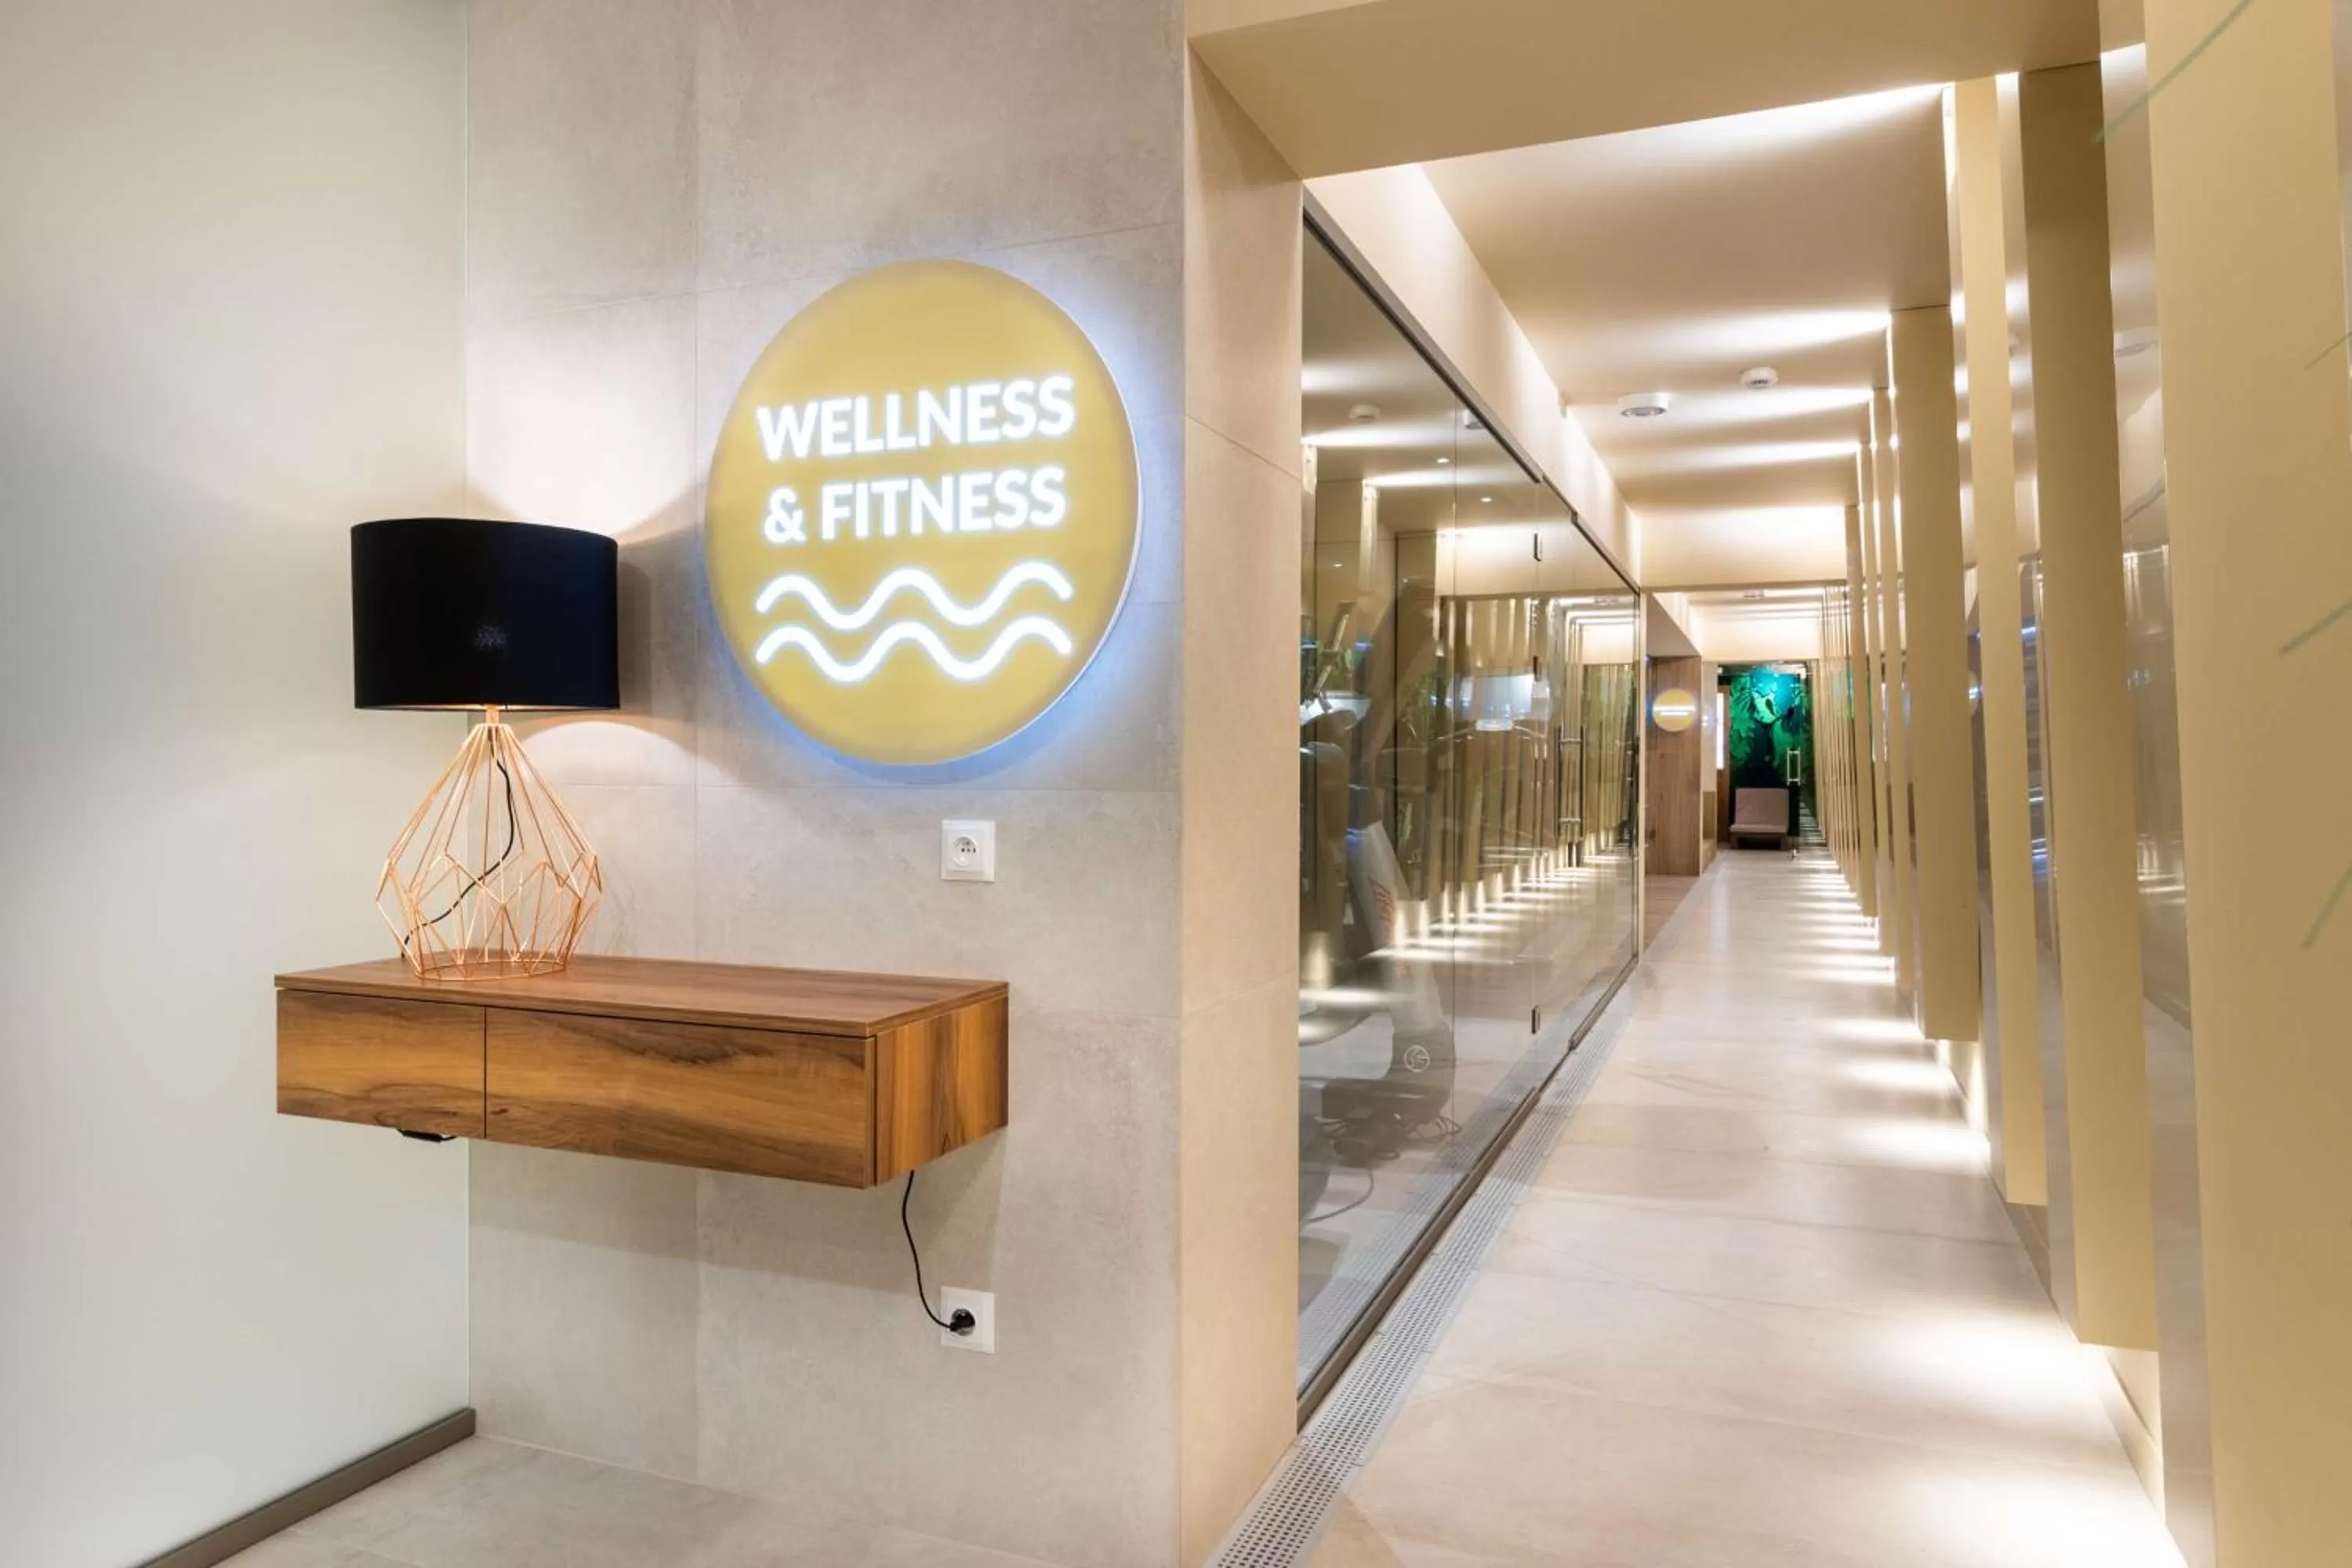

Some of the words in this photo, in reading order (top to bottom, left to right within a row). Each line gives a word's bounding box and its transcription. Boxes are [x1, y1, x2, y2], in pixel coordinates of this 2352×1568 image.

[756, 375, 1074, 461] WELLNESS
[764, 487, 806, 543] &
[821, 466, 1066, 540] FITNESS
